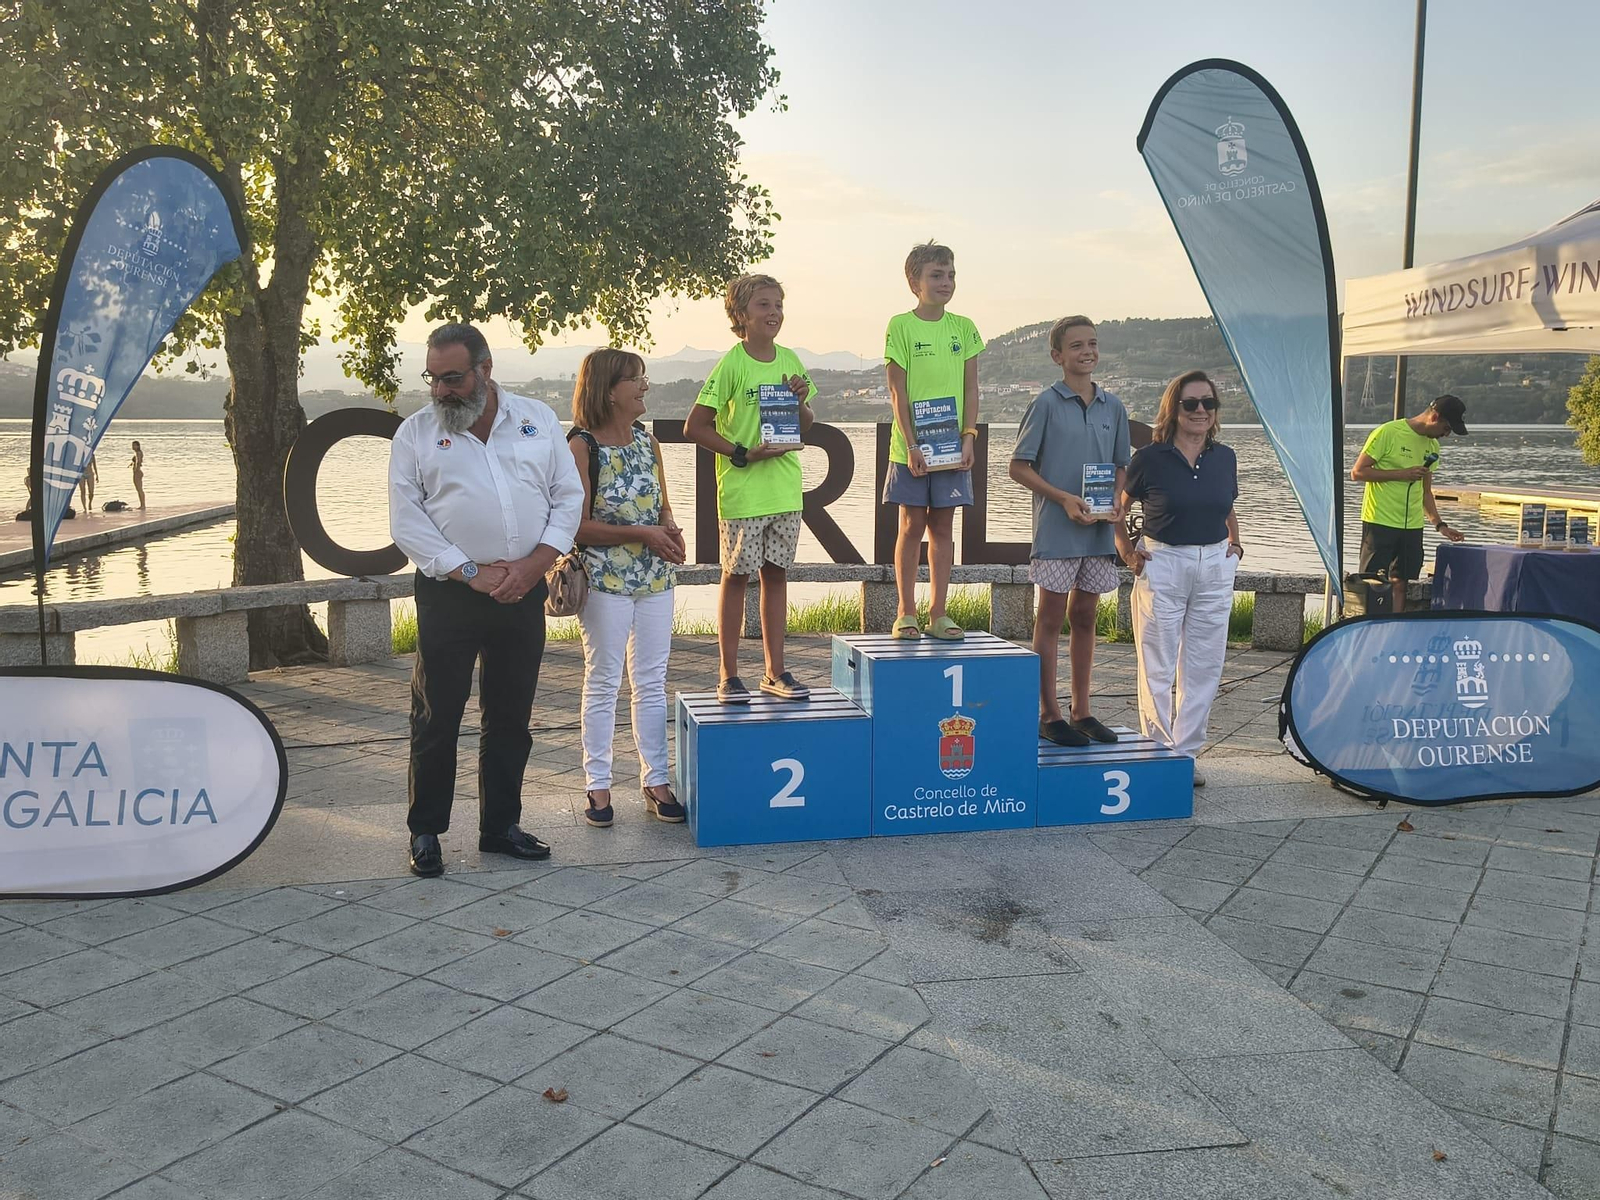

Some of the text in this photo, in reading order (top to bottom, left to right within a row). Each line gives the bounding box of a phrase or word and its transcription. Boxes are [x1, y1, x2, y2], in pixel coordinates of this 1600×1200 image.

[107, 244, 180, 282] DEPUTACIÓN
[914, 401, 931, 409] COPA
[915, 404, 951, 415] DEPUTACIÓN
[943, 664, 964, 708] 1
[1391, 710, 1551, 739] DEPUTACIÓN
[0, 741, 108, 778] NTA
[1417, 743, 1534, 767] OURENSE
[768, 757, 806, 809] 2
[913, 783, 998, 801] Concello de
[1099, 770, 1132, 816] 3
[3, 788, 218, 829] GALICIA
[884, 798, 1026, 821] Castrelo de Miño
